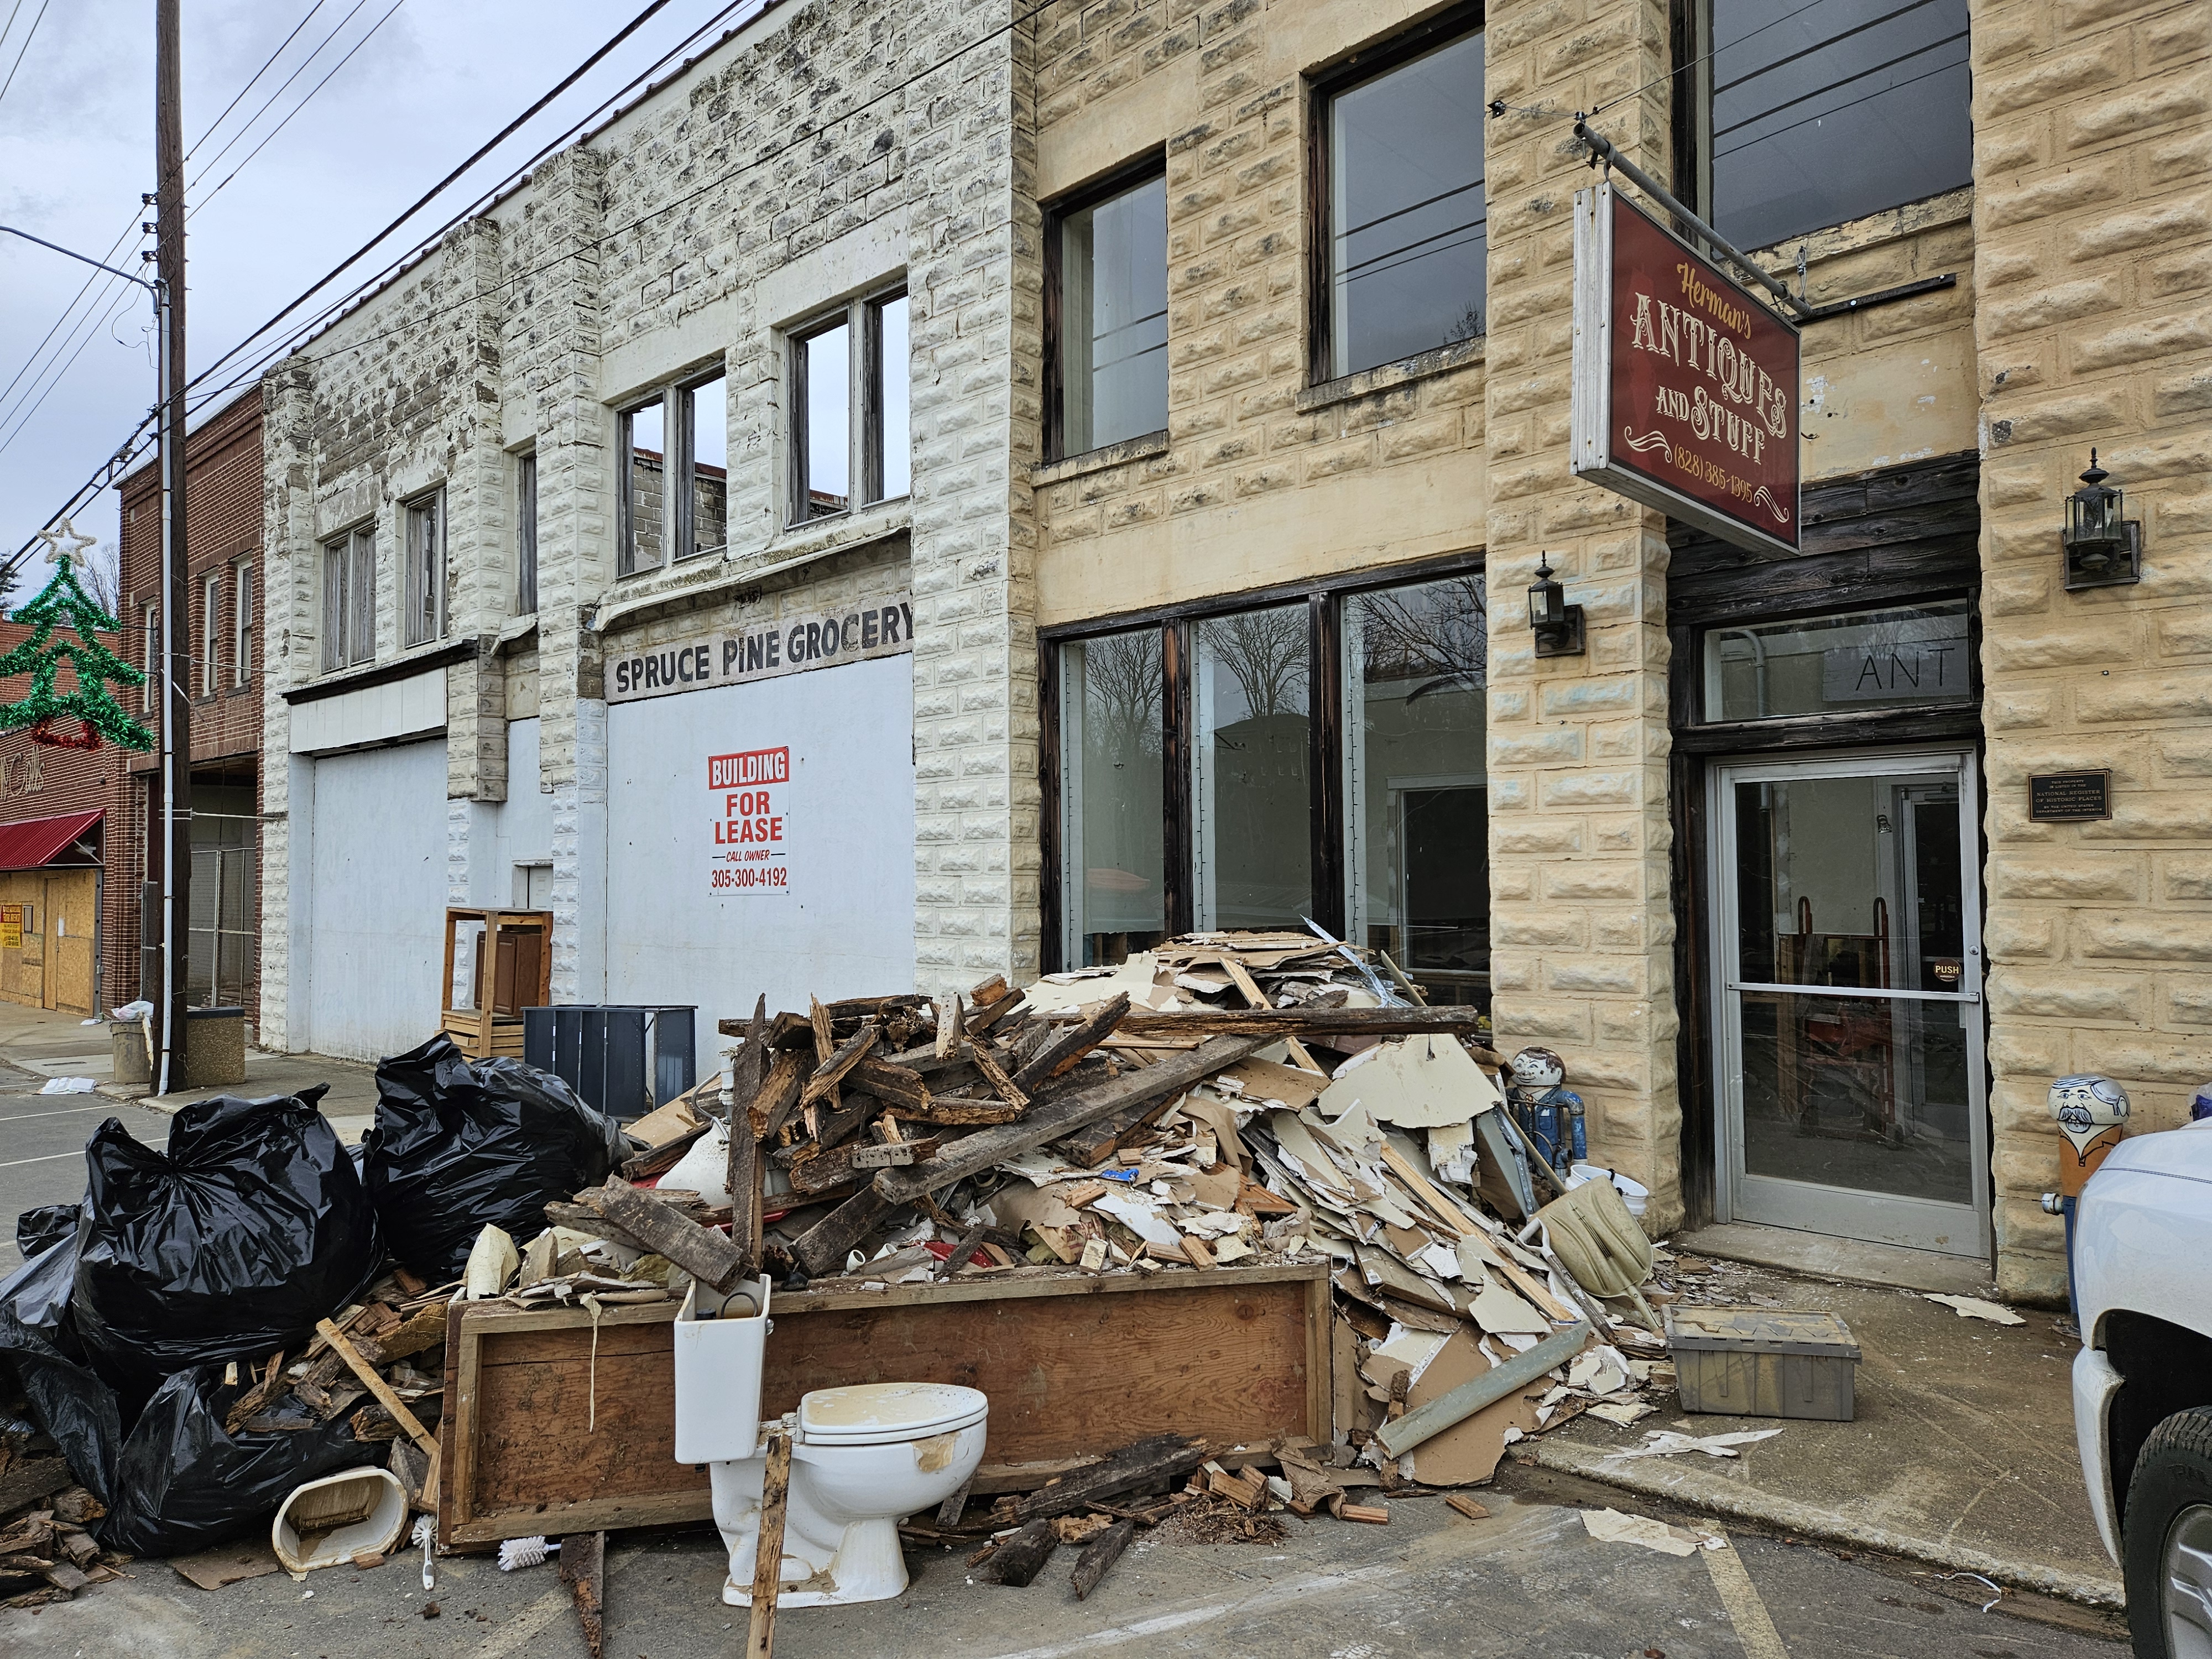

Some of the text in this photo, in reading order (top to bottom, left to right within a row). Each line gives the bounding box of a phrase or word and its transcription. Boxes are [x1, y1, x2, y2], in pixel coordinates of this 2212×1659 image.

[1676, 262, 1751, 340] Herman's
[1630, 292, 1787, 439] ANTIQUES
[1655, 385, 1766, 465] AND STUFF
[1674, 443, 1753, 503] (828) 385-1395
[616, 601, 914, 693] SPRUCE PINE GROCERY
[1855, 647, 1955, 691] ANT
[712, 751, 785, 786] BUILDING
[726, 791, 770, 817] FOR
[715, 816, 782, 844] LEASE
[726, 849, 770, 863] CALL OWNER
[711, 867, 787, 888] 305-300-4192
[1936, 965, 1959, 974] PUSH
